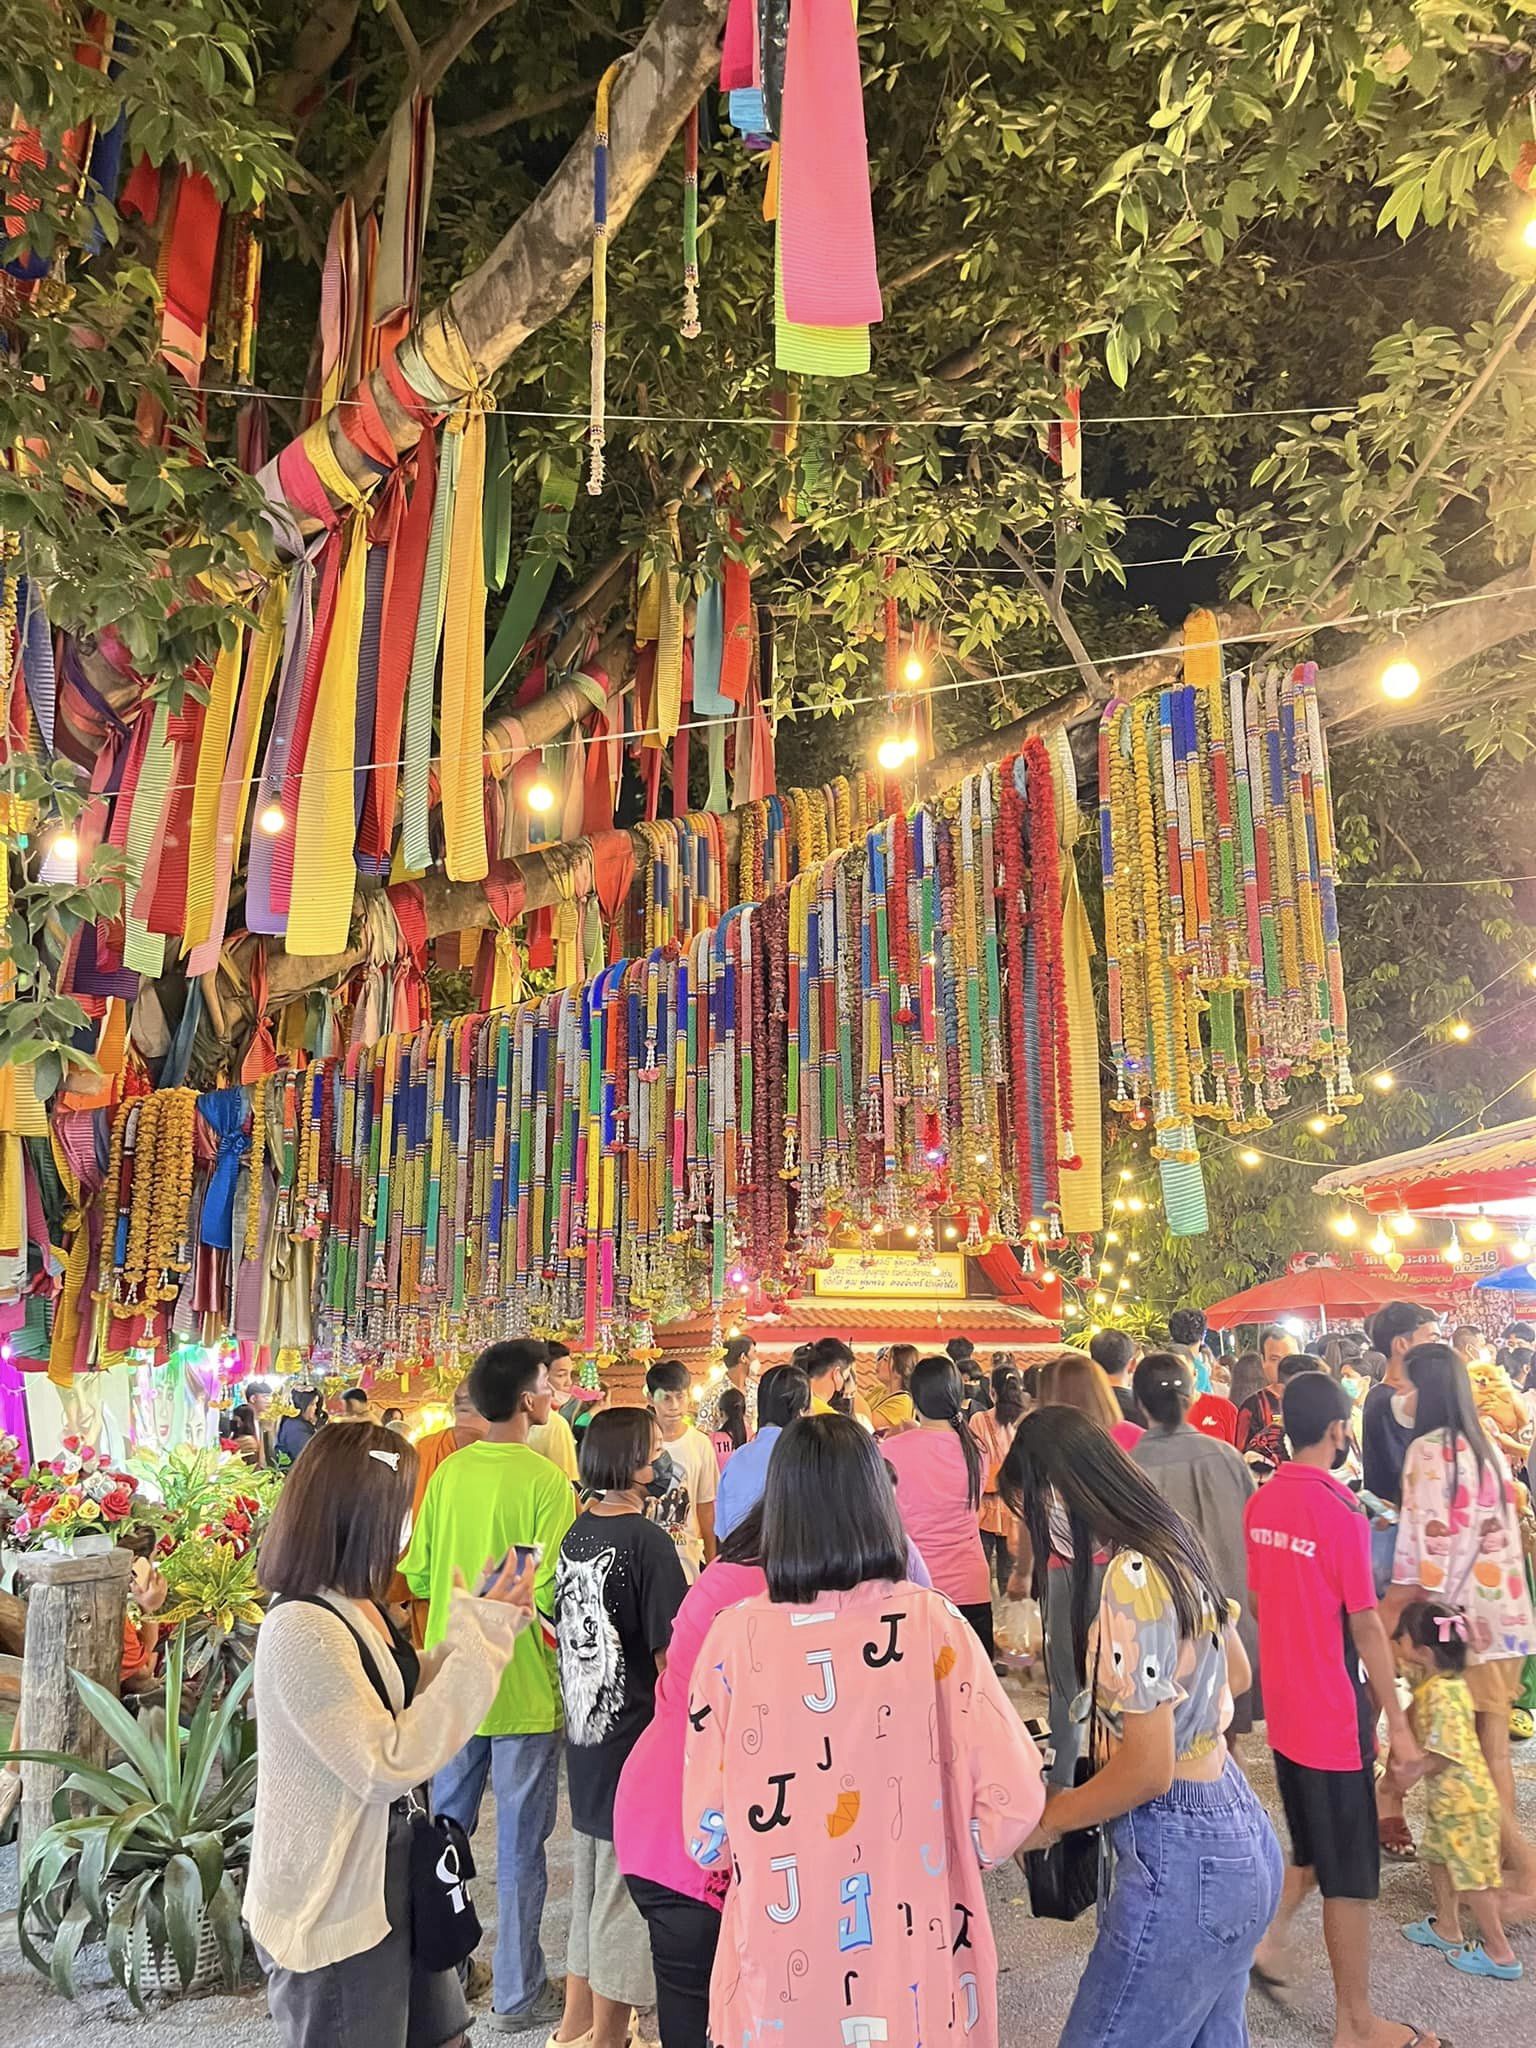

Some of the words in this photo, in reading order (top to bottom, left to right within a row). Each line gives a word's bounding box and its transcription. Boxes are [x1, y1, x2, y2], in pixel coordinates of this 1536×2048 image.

[863, 1612, 907, 1668] J
[802, 1648, 838, 1713] J
[816, 1736, 833, 1771] J
[748, 1771, 797, 1833] J
[765, 1852, 801, 1924] J
[838, 1871, 873, 1952] J
